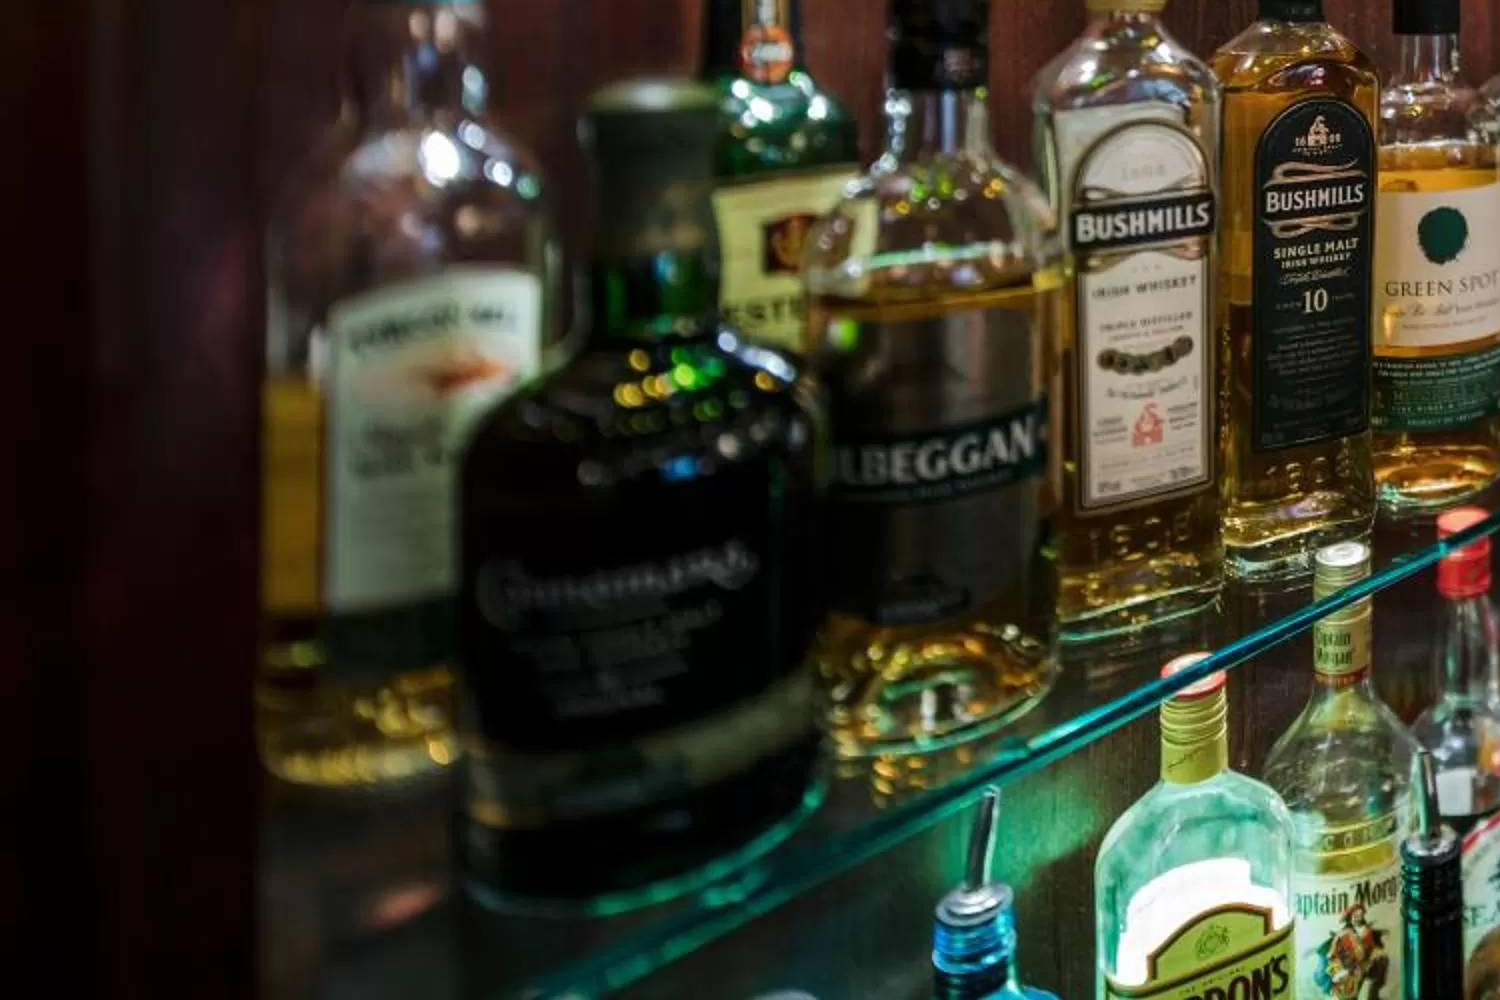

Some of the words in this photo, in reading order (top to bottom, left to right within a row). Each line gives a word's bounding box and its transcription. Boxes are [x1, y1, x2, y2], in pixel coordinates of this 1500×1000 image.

[1265, 184, 1365, 213] BUSHMILLS
[1076, 202, 1210, 243] BUSHMILLS
[1273, 243, 1321, 260] SINGLE
[1324, 237, 1360, 253] MALT
[1385, 279, 1453, 297] GREEN
[1459, 269, 1498, 293] SPOT
[1302, 288, 1328, 314] 10
[832, 414, 1036, 488] LBEGGAN
[1295, 887, 1349, 920] aptain
